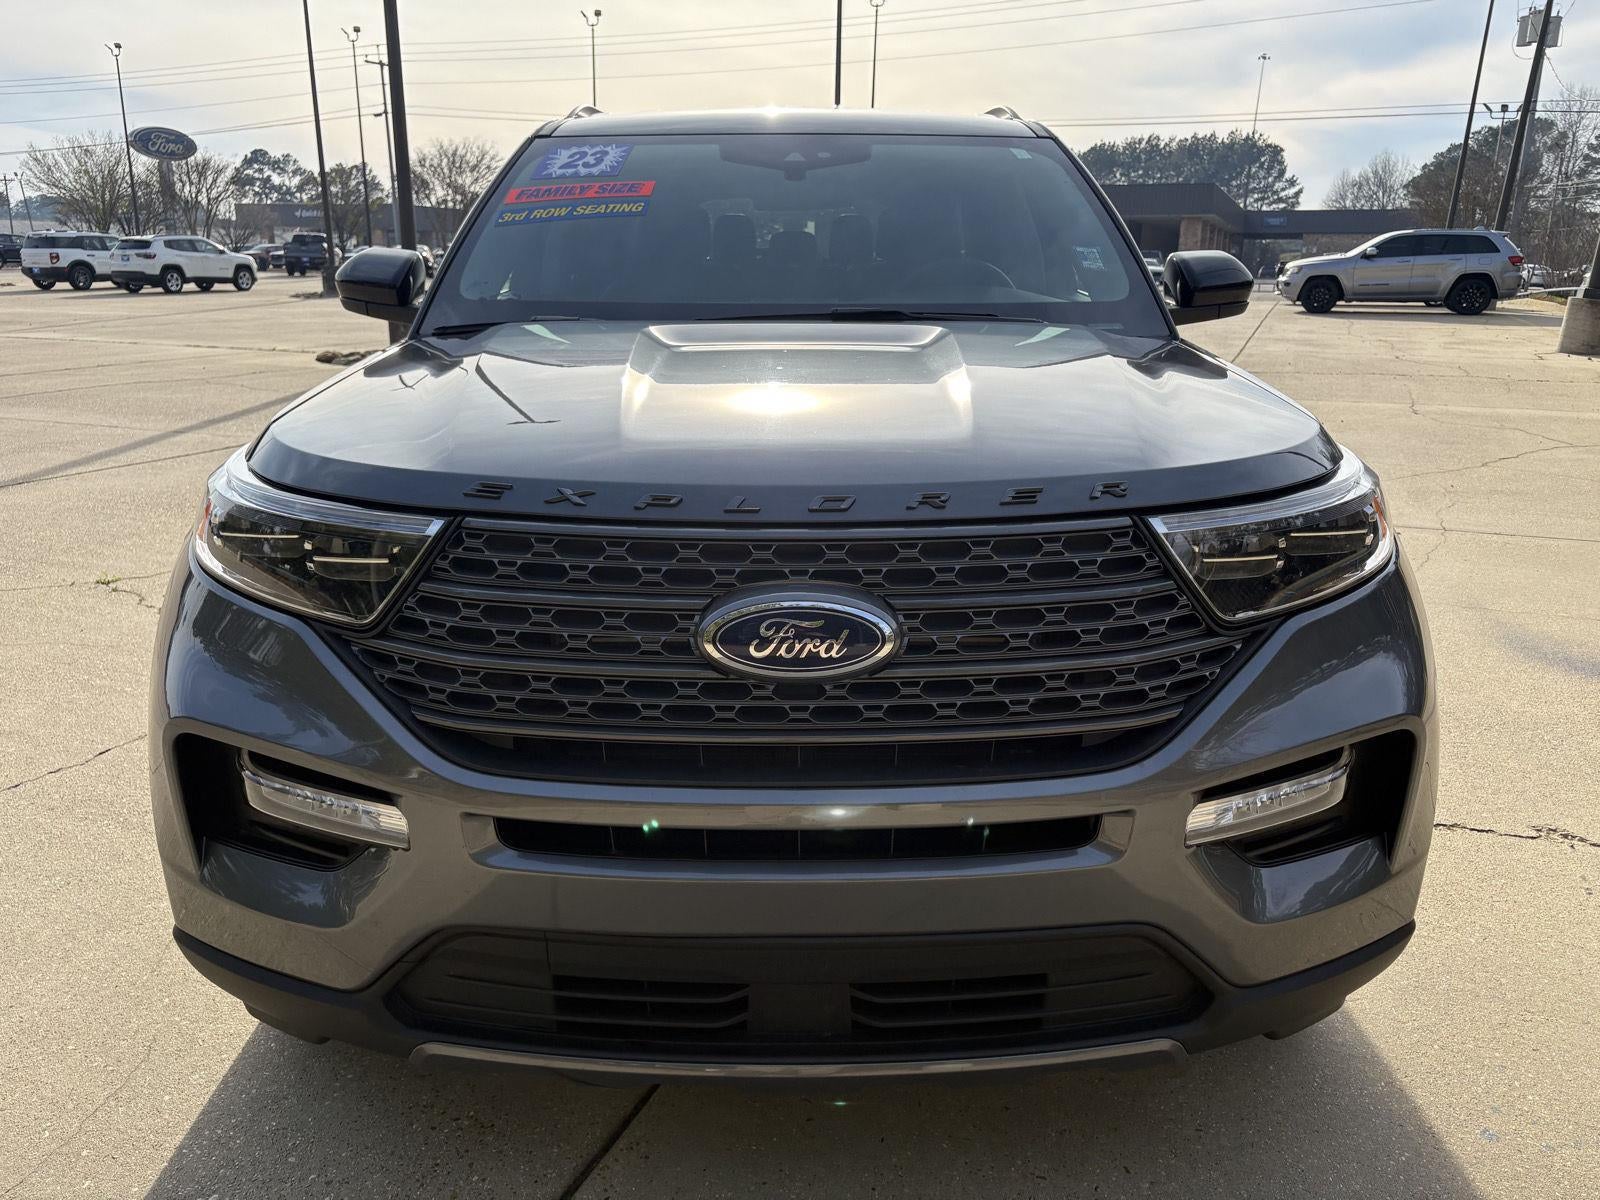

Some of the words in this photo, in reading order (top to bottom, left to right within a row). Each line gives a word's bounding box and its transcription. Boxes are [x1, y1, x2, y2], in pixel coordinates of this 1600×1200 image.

[148, 132, 187, 153] Ford
[558, 150, 610, 170] 23
[515, 184, 594, 201] FAMILY
[594, 182, 642, 195] SIZE
[498, 210, 529, 223] 3rd
[530, 205, 573, 219] ROW
[573, 202, 645, 216] SEATING
[462, 480, 1130, 514] EXPLORER
[749, 617, 850, 659] Ford
